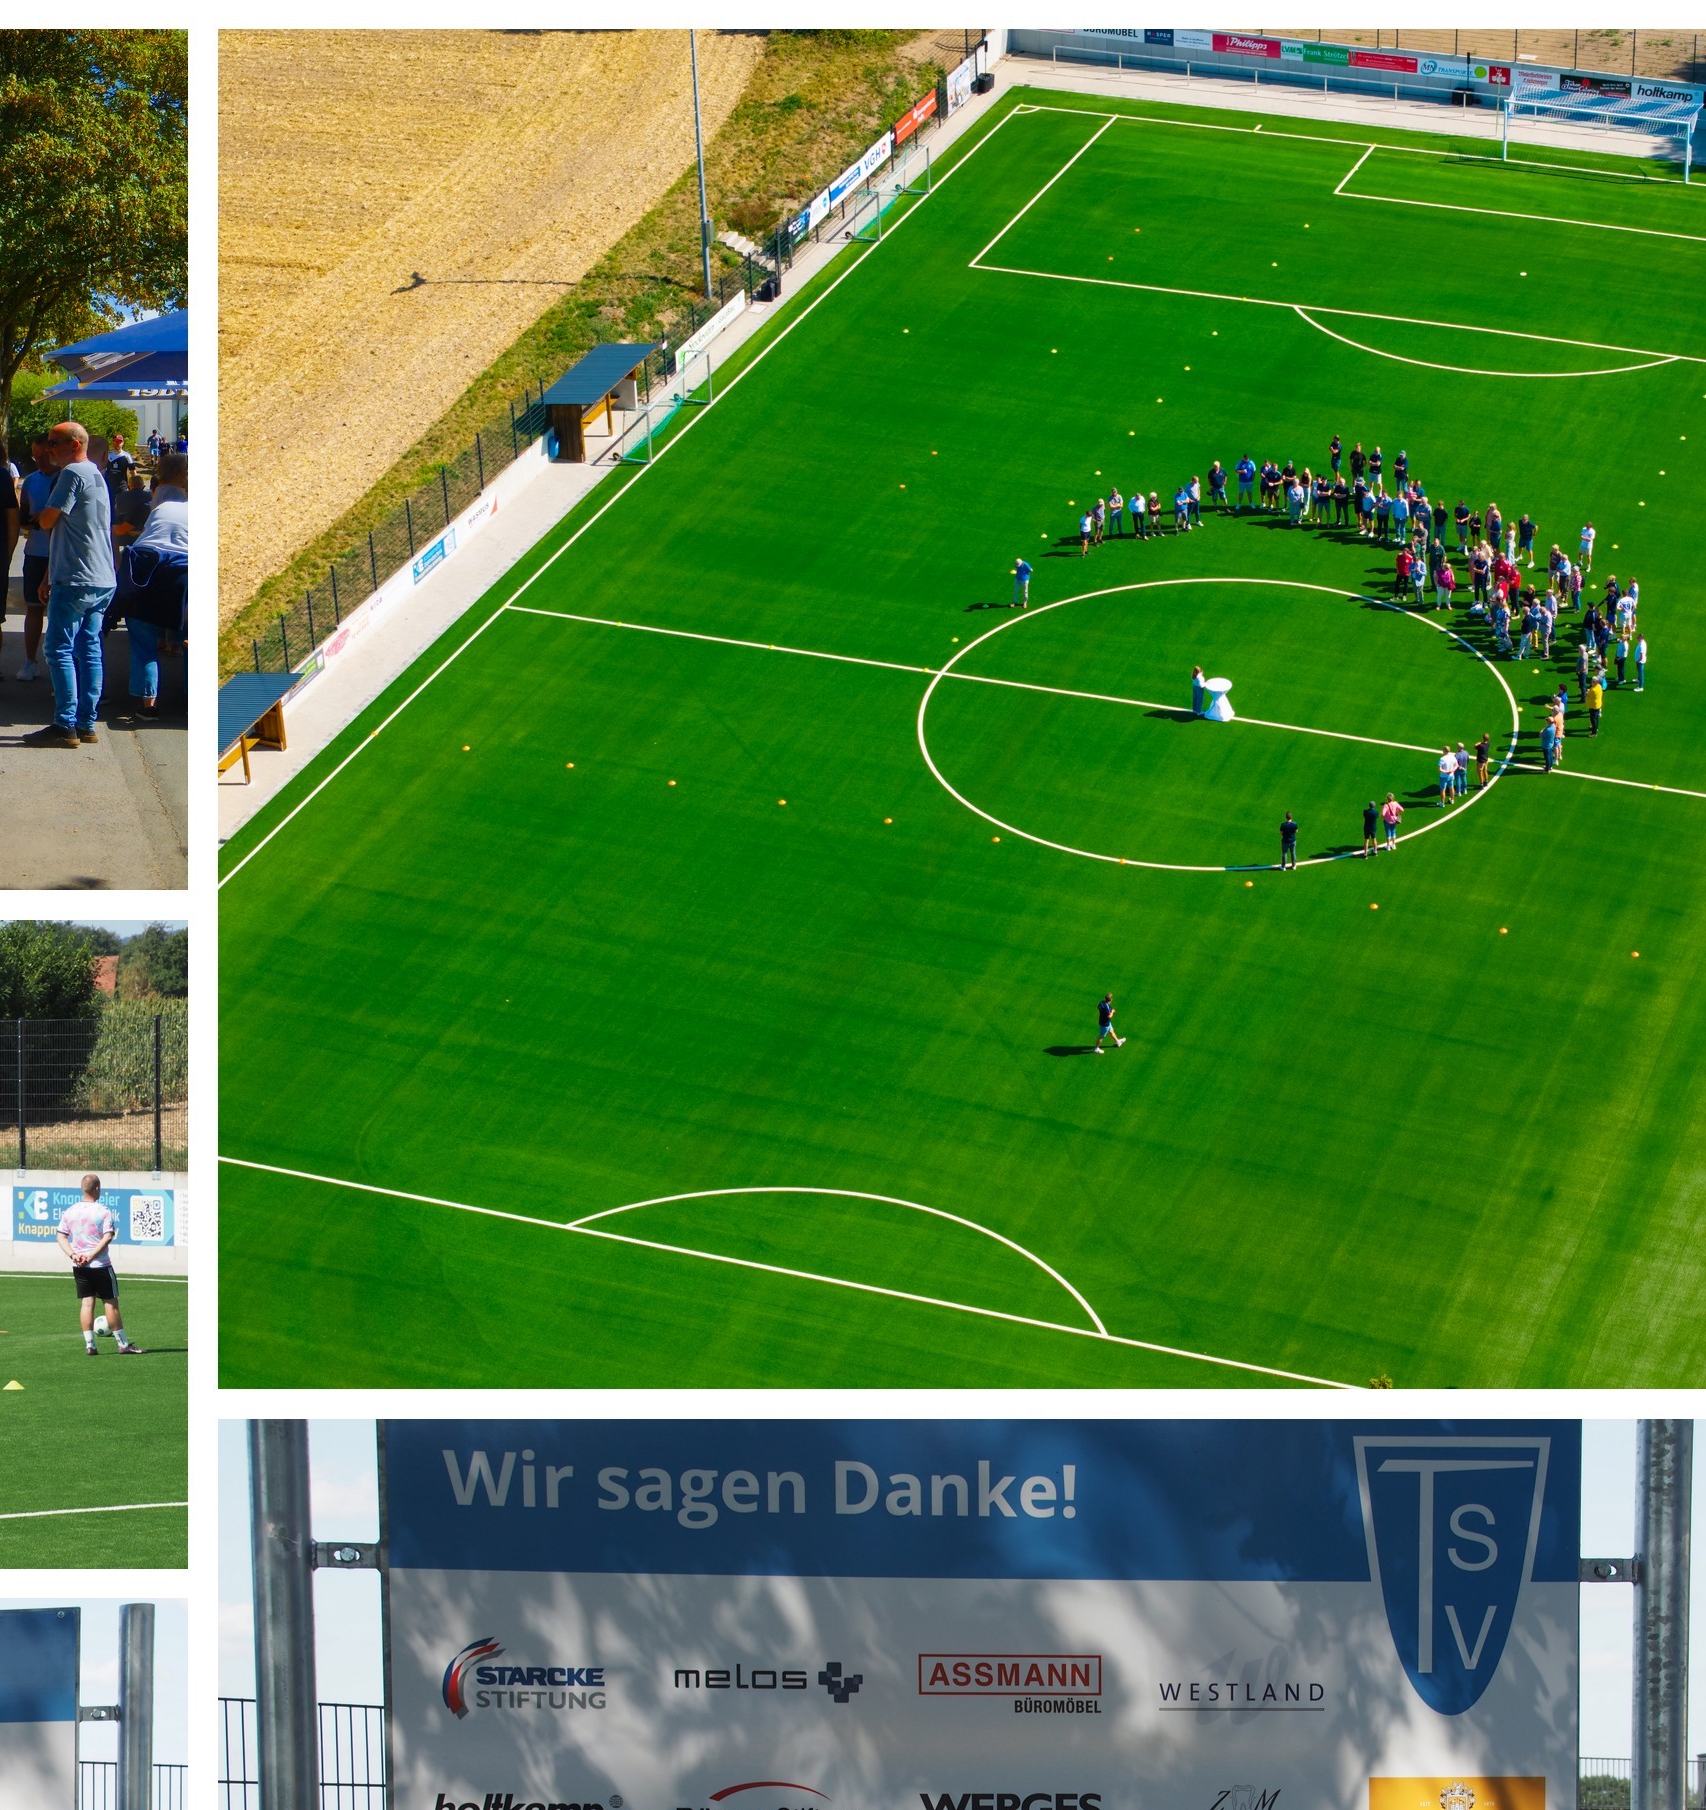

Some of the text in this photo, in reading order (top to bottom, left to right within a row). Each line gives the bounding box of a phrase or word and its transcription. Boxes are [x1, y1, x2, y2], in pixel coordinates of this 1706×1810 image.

[1230, 36, 1268, 50] Philipps
[1304, 48, 1321, 57] Frank
[1637, 85, 1693, 104] holtkamp
[863, 147, 882, 171] VGH
[442, 1449, 1077, 1530] Wir sagen Danke!
[1376, 1459, 1536, 1674] TSV
[475, 1665, 607, 1688] STARCKE
[674, 1663, 808, 1690] melos
[928, 1661, 1092, 1688] ASSMANN
[476, 1690, 607, 1710] STIFTUNG
[1159, 1682, 1325, 1703] WESTLAND
[1014, 1696, 1102, 1714] BÜROMÖBEL
